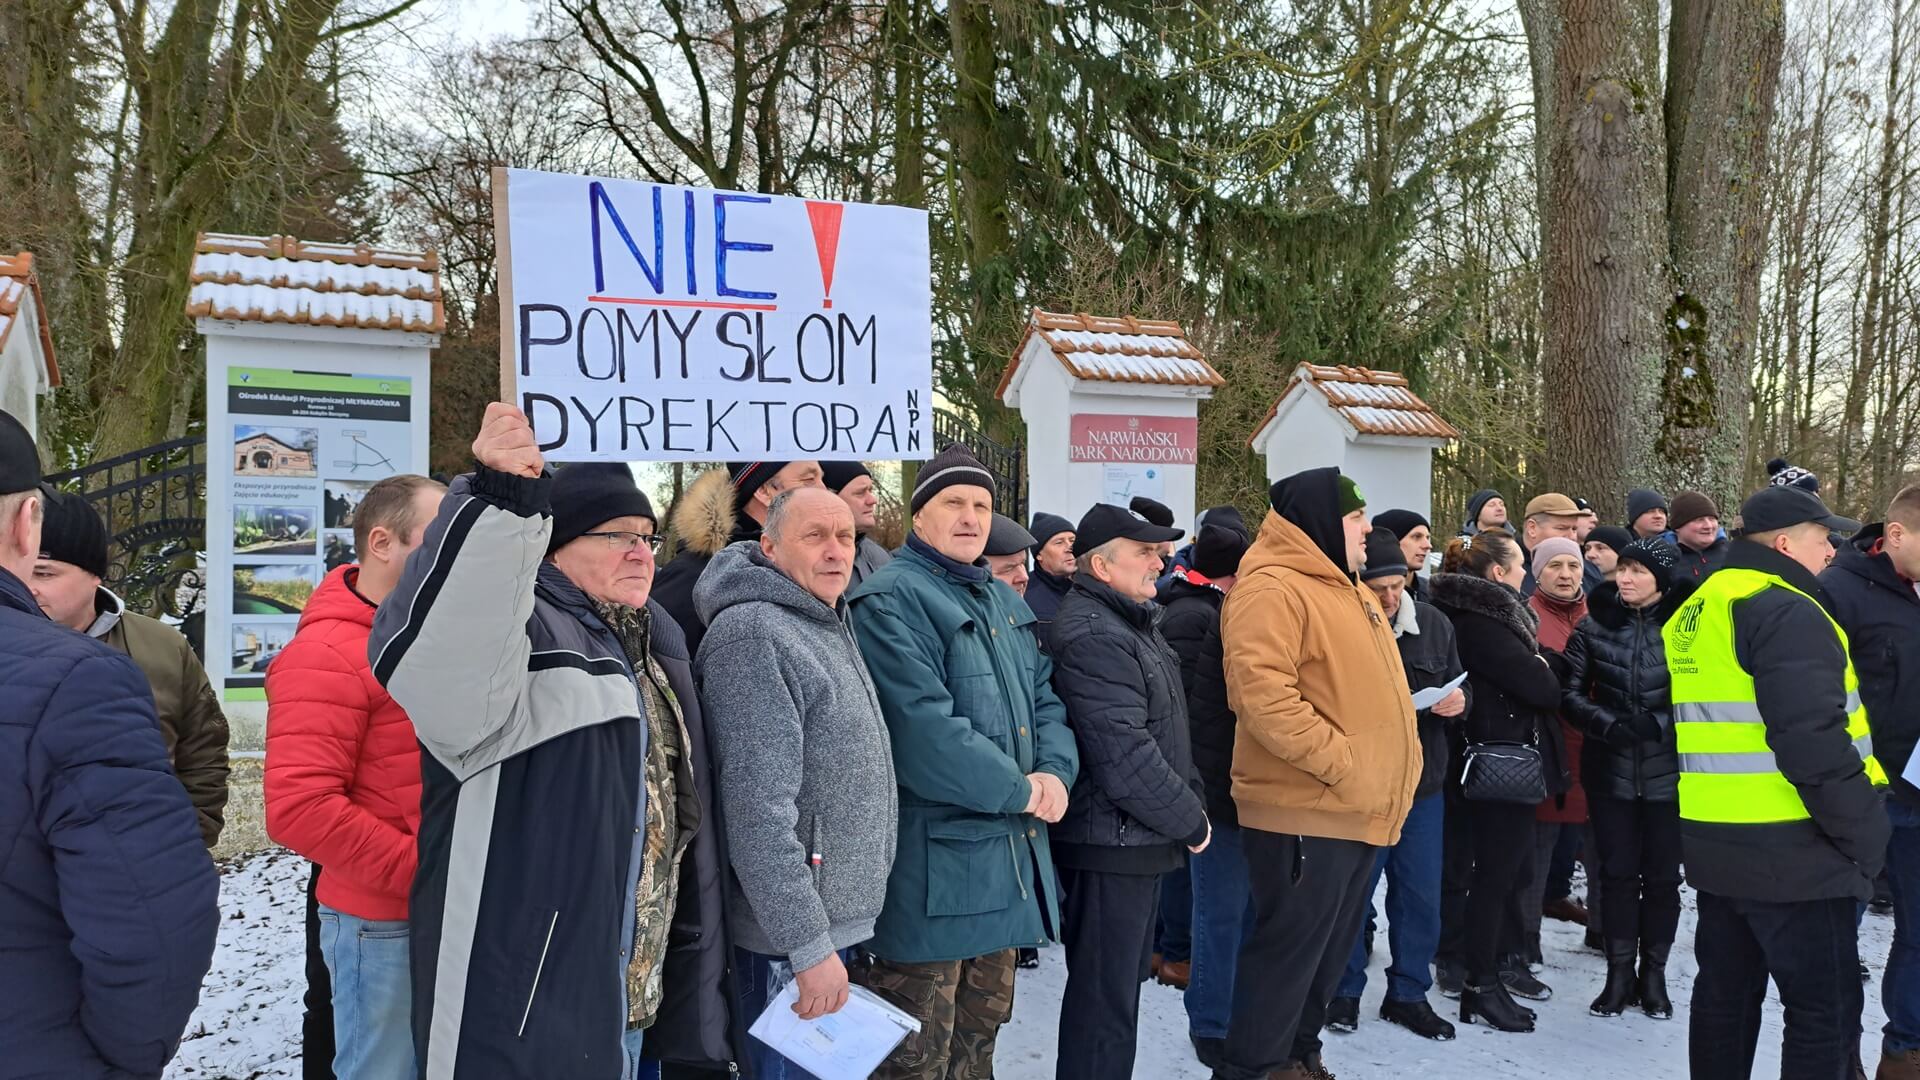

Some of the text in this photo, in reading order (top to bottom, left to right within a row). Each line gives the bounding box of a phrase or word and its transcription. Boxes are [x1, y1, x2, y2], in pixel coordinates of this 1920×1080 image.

[589, 181, 778, 299] NIE
[520, 303, 877, 386] POMYSŁOM
[522, 392, 899, 453] DYREKTORA
[1070, 444, 1196, 462] PARK NARODOWY
[1087, 428, 1178, 447] NARWIAŃSKI
